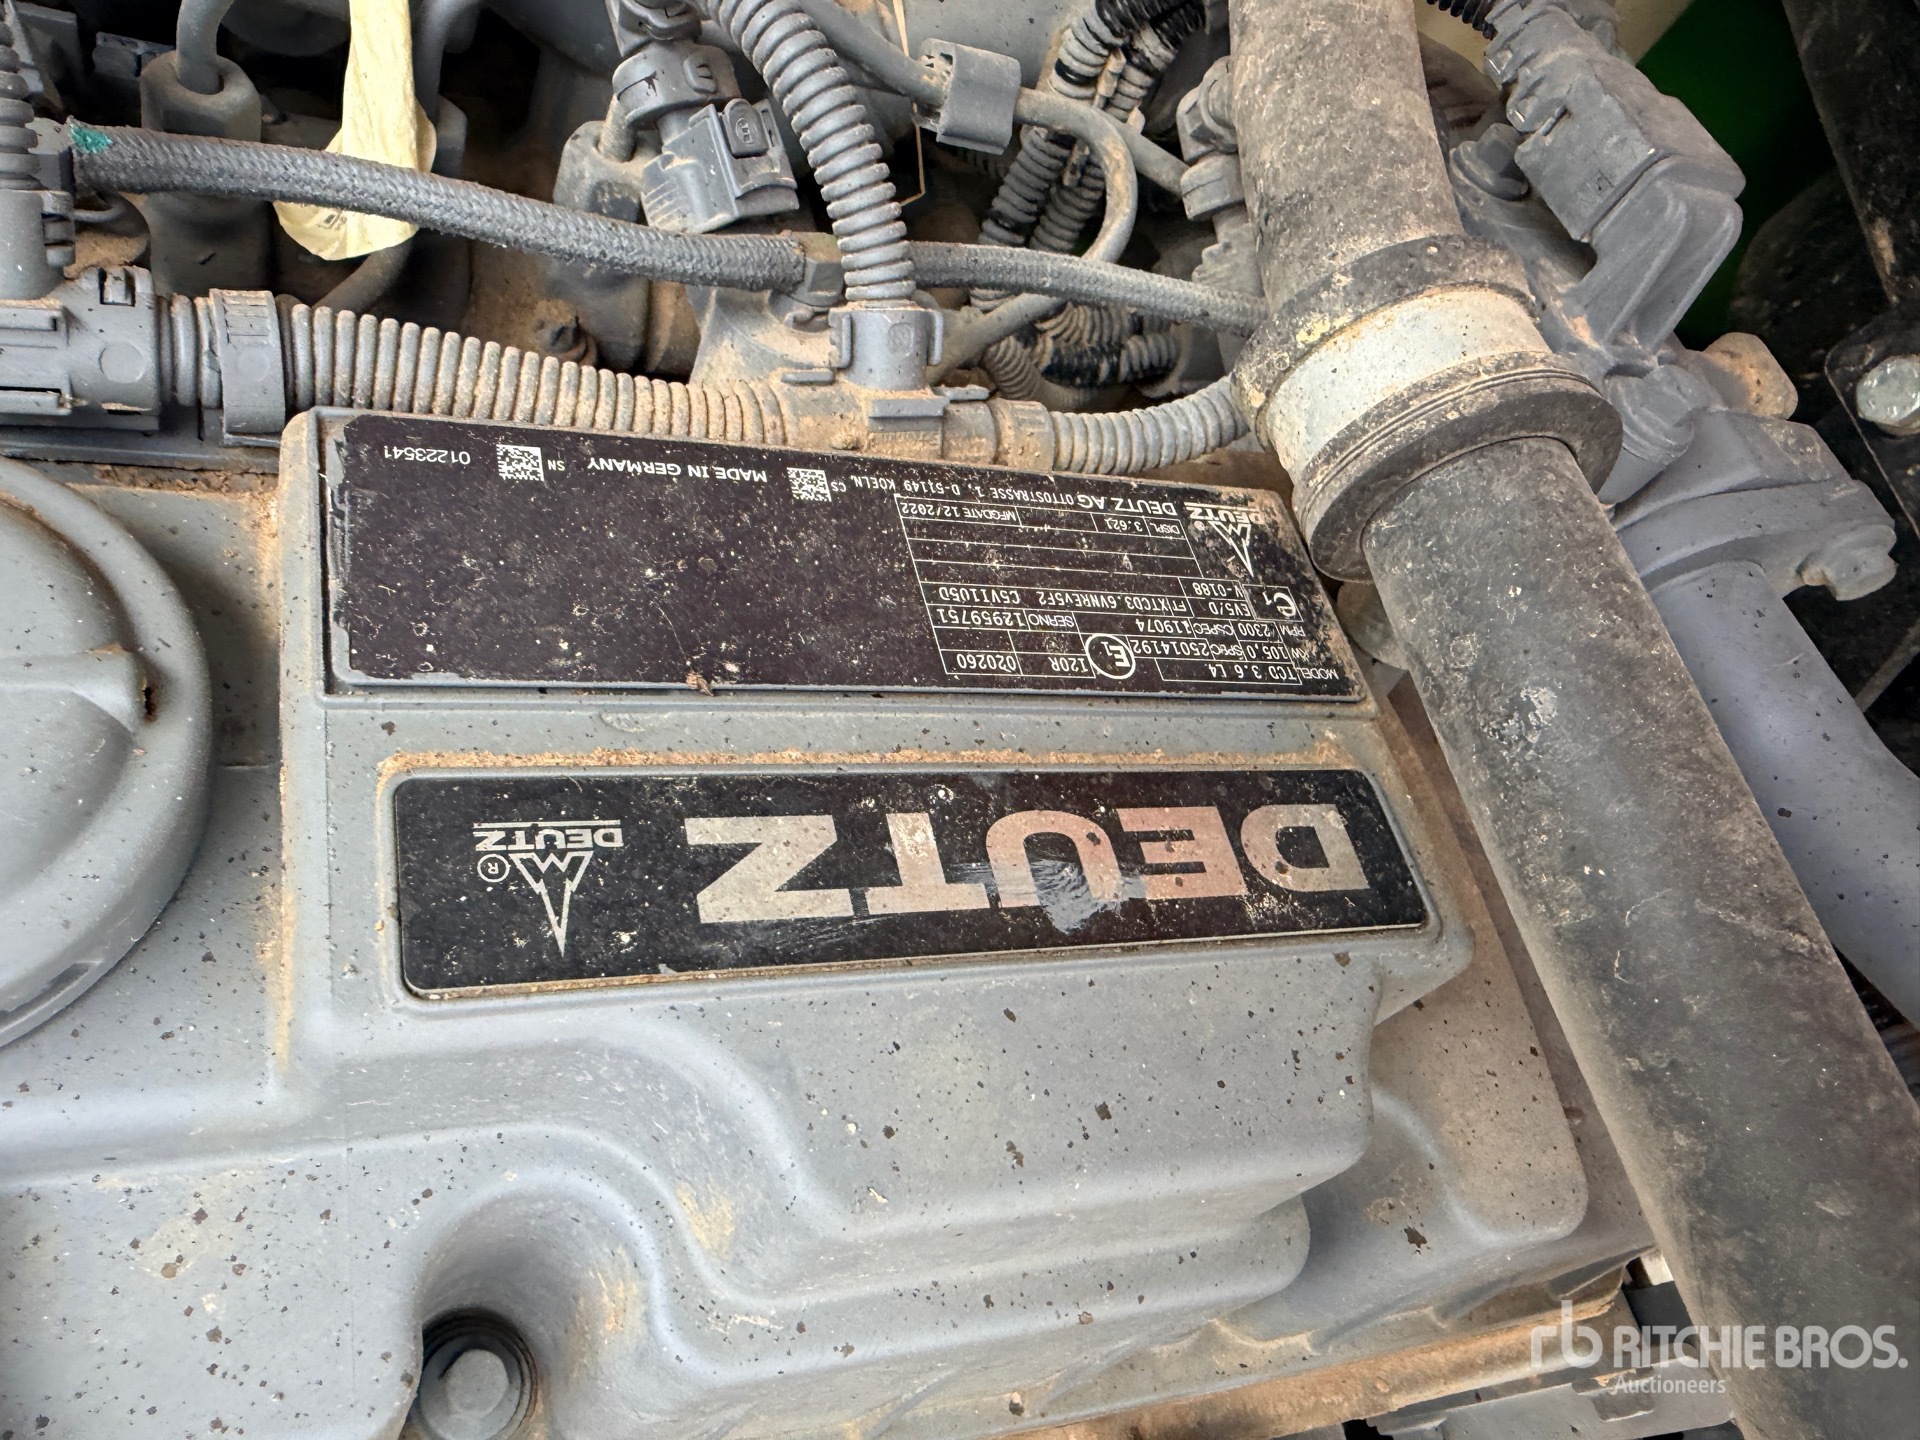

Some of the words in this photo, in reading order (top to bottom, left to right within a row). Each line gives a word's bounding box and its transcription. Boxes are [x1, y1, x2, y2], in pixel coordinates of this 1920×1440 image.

[384, 445, 470, 465] 01223541
[548, 459, 565, 471] SN
[587, 457, 681, 476] GERMANY
[687, 465, 708, 478] IN
[713, 466, 767, 483] MADE
[831, 481, 846, 492] CS
[903, 480, 960, 495] D-51149
[991, 487, 1074, 505] OTTOSTRASSE
[1076, 495, 1105, 510] AG
[900, 502, 960, 517] 12/2022
[963, 507, 1016, 521] MFGDATE
[1110, 497, 1178, 516] DEUTZ
[1104, 518, 1142, 532] 3.621
[1149, 522, 1180, 534] DISPL
[1192, 582, 1243, 598] V-0188
[936, 608, 1025, 627] 12959751
[1028, 613, 1074, 627] SERNO
[1135, 618, 1191, 634] 119074
[1193, 622, 1234, 635] CSPEC
[1238, 622, 1270, 638] 2300
[1279, 625, 1306, 637] RPM
[1130, 639, 1209, 656] 25014192
[1210, 644, 1243, 656] SPEC
[1246, 643, 1288, 659] 105,0
[957, 654, 1017, 671] 020260
[1234, 664, 1262, 679] 3.6
[1268, 666, 1296, 680] TCD
[1295, 667, 1339, 680] MODEL
[473, 827, 624, 851] DEUTZ
[684, 803, 1372, 924] DEUTZ
